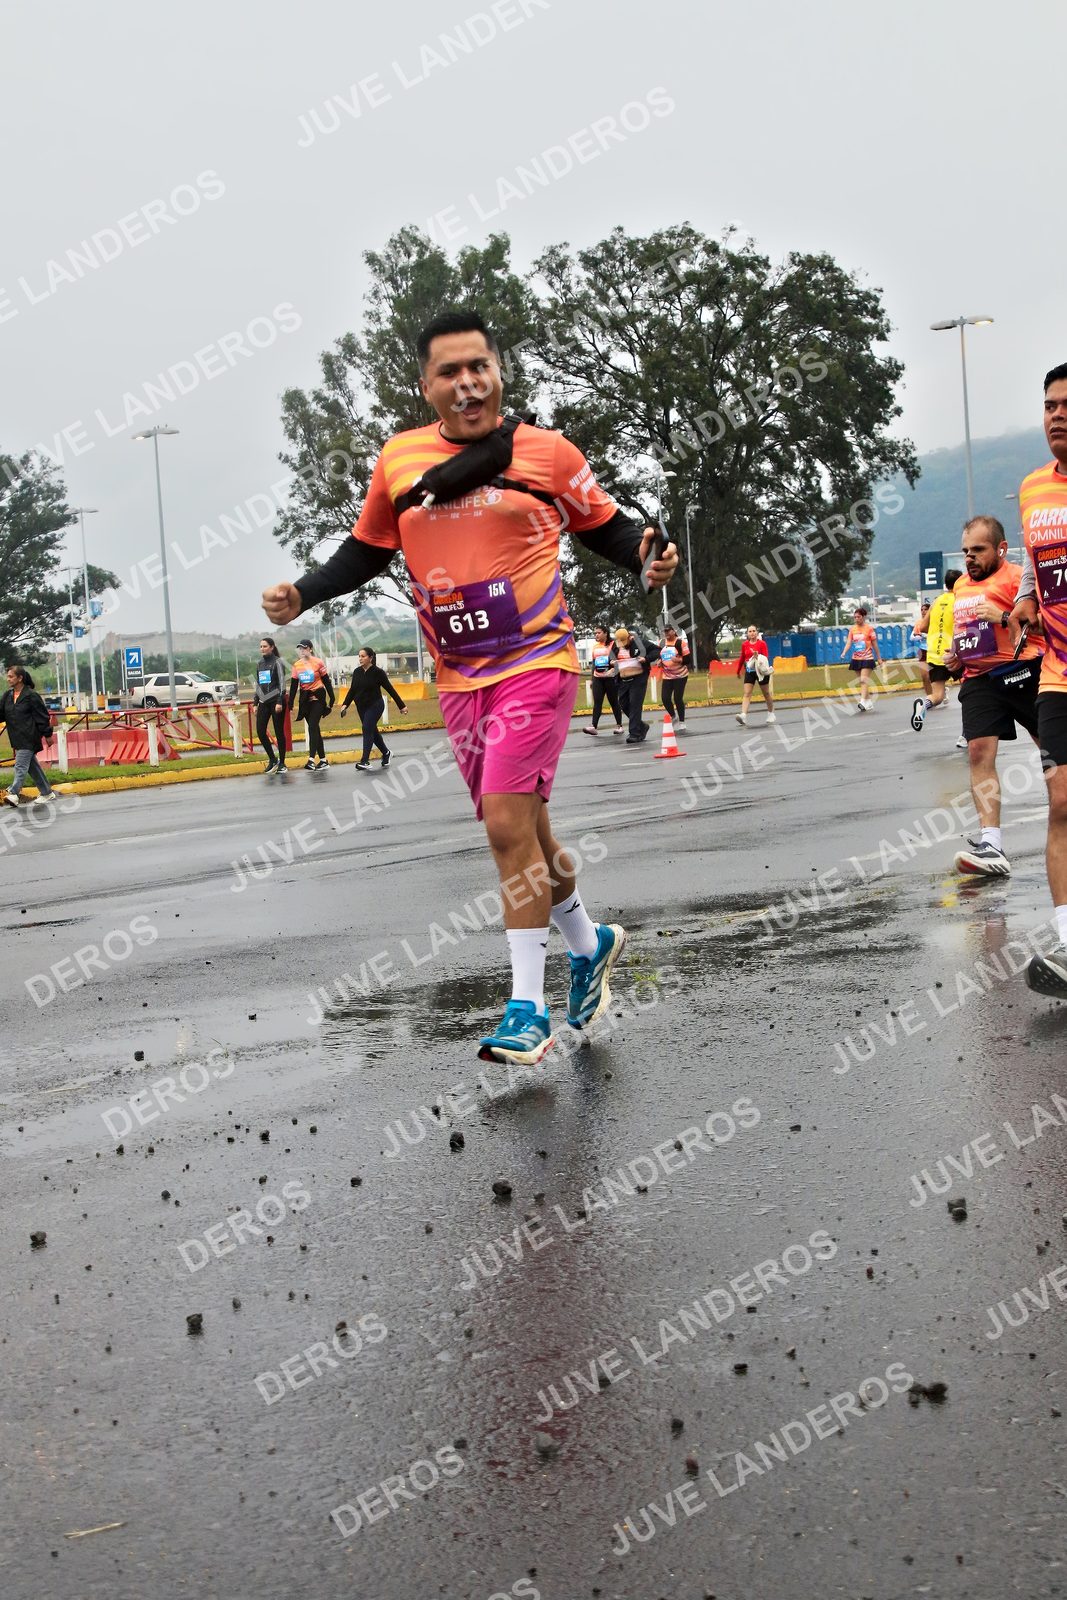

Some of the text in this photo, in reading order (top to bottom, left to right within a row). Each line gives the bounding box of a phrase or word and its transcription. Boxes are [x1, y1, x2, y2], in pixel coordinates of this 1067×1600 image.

[1037, 547, 1067, 561] CARRERA
[925, 568, 937, 585] E
[1052, 567, 1067, 587] 7
[488, 582, 506, 597] 15K
[449, 609, 490, 634] 613
[959, 635, 979, 651] 547
